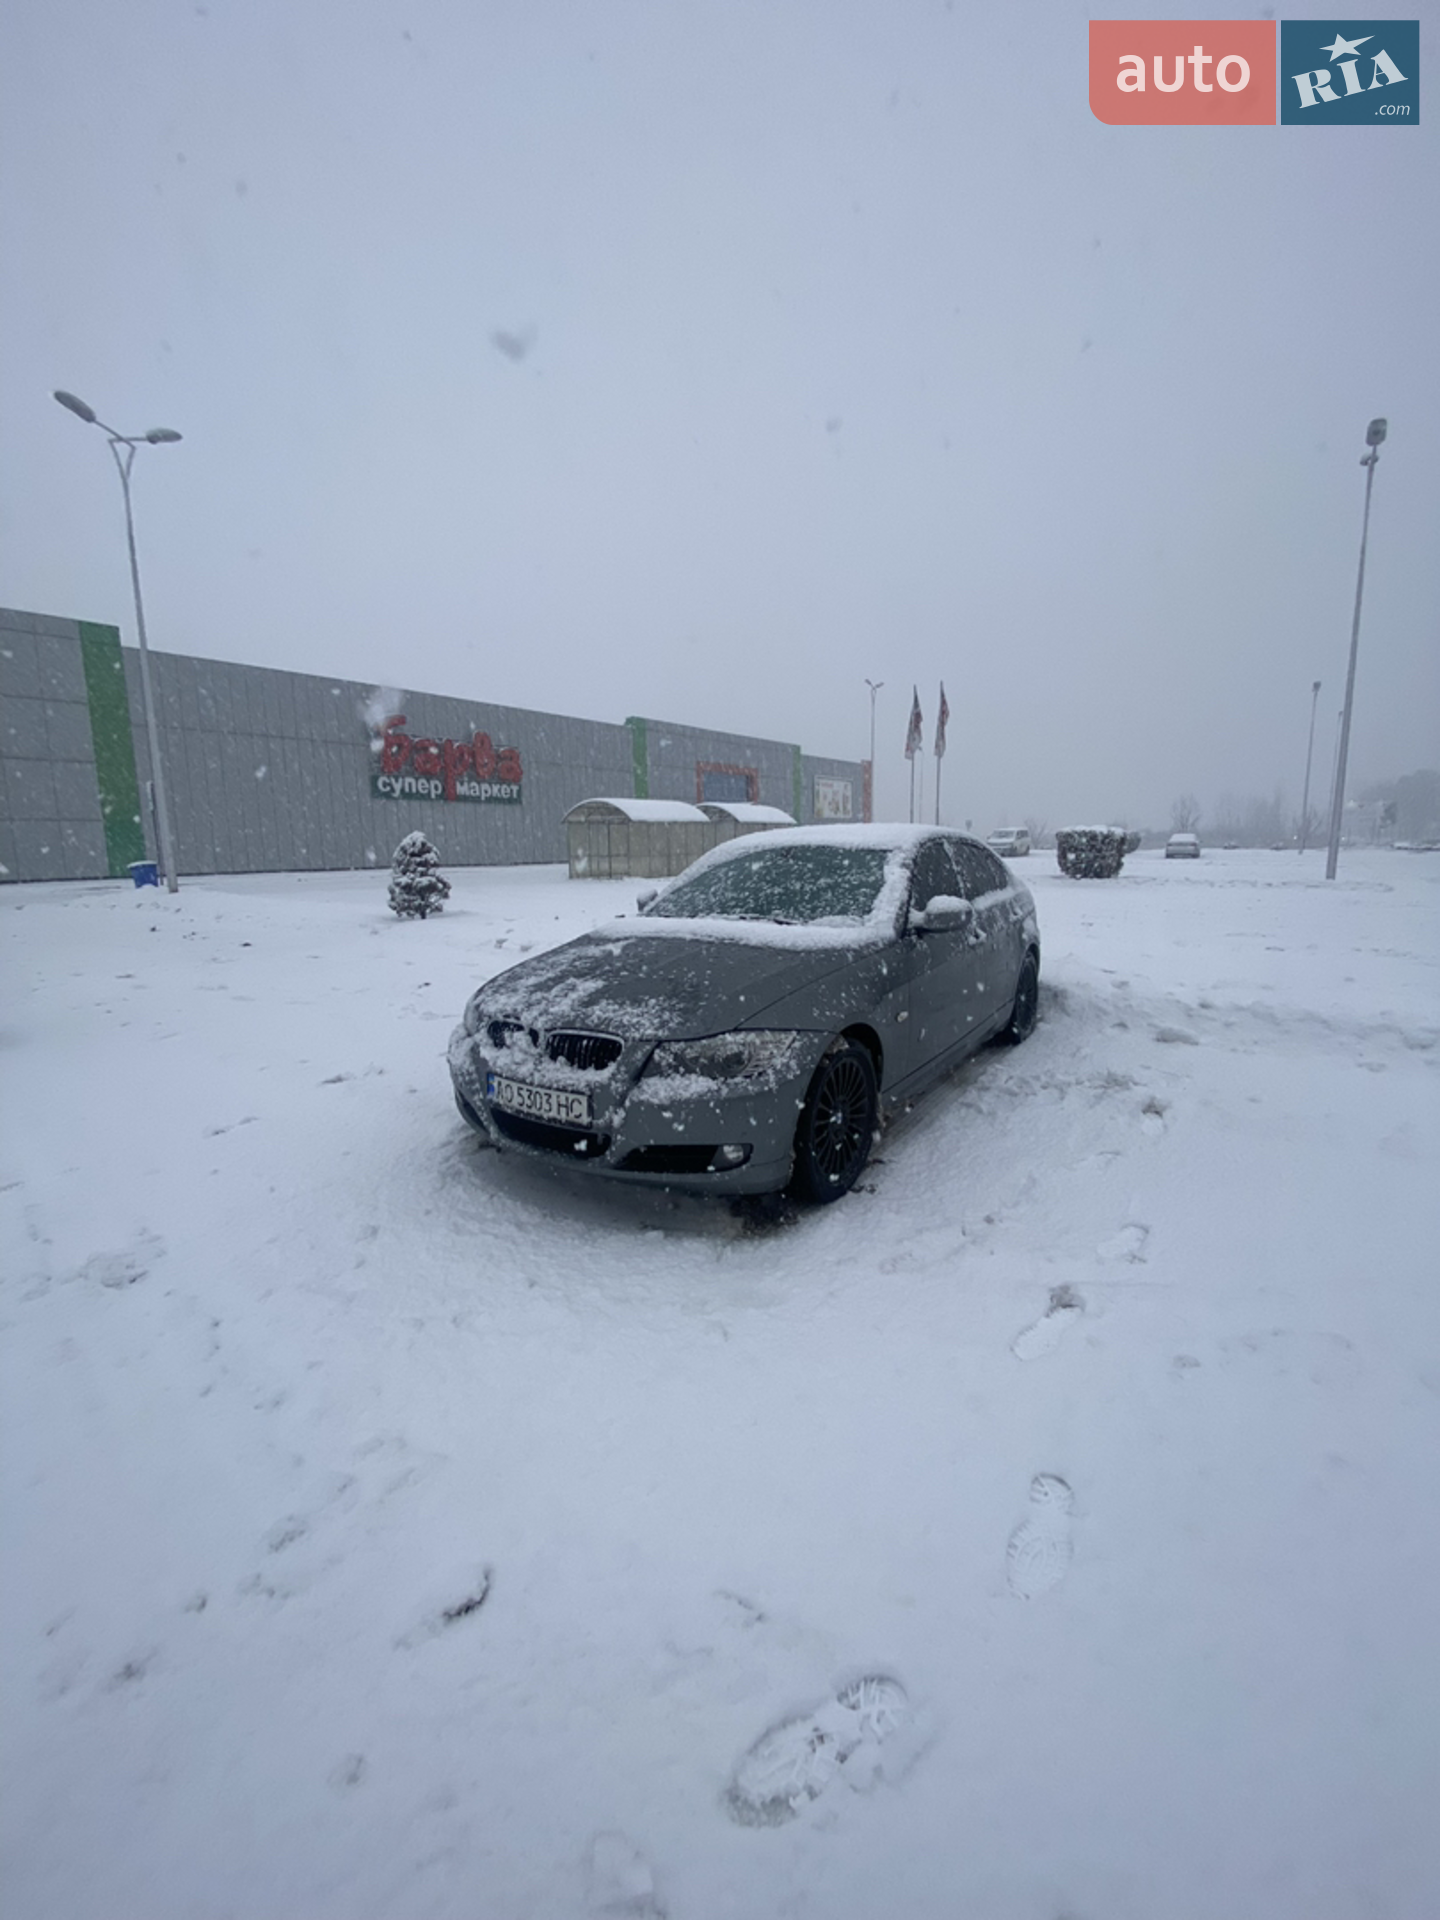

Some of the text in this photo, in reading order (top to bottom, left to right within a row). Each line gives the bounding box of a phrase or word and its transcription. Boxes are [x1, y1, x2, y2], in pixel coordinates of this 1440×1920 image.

[377, 775, 520, 801] супер маркет
[516, 1087, 552, 1113] 5303
[556, 1094, 582, 1119] HC
